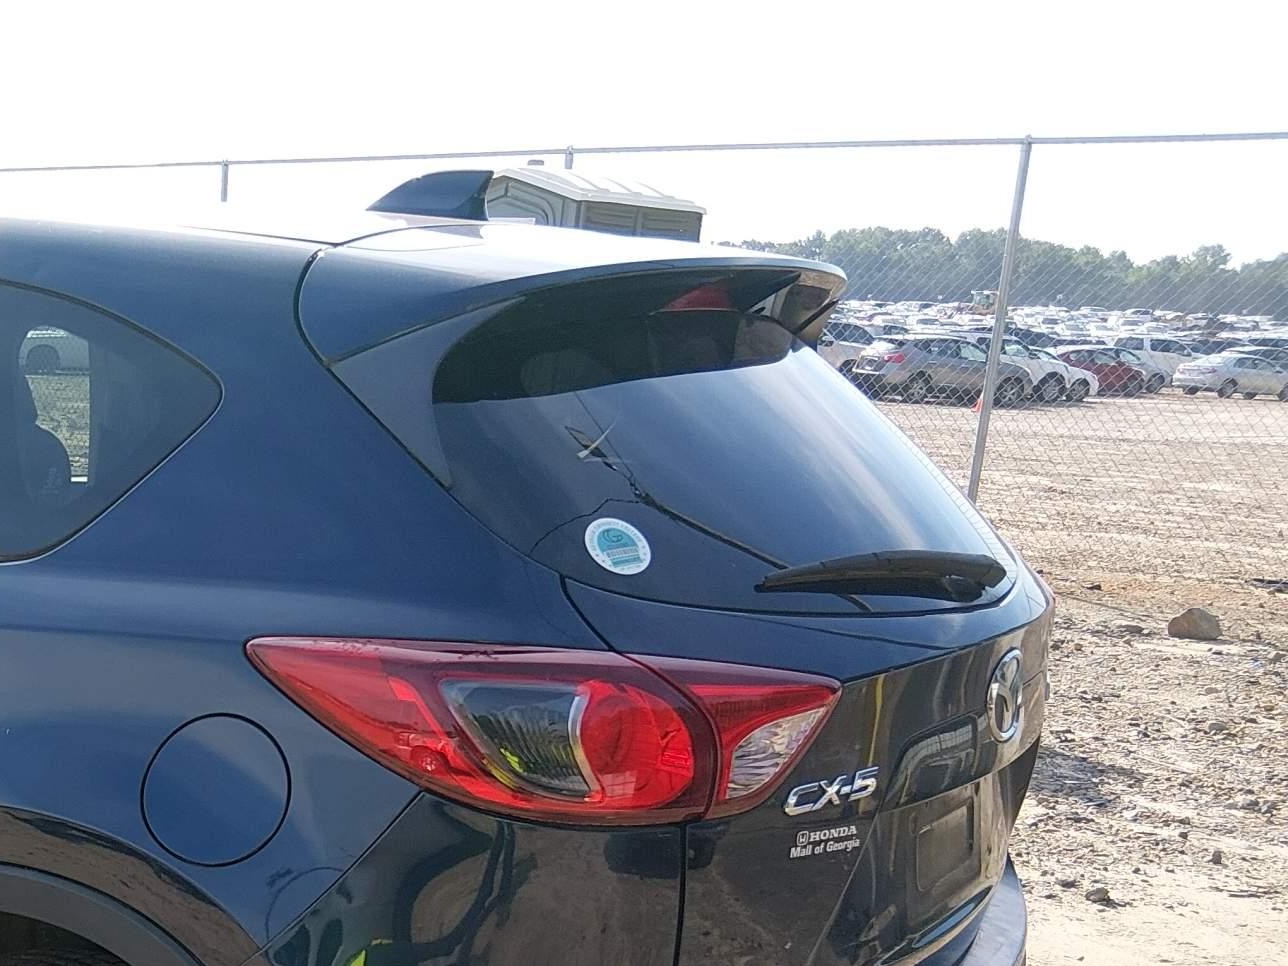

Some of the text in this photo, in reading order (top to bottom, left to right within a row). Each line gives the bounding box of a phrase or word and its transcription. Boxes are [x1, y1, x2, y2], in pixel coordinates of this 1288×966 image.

[783, 766, 880, 816] CX-5
[809, 825, 857, 842] HONDA
[790, 838, 860, 858] Mall of Georgia
